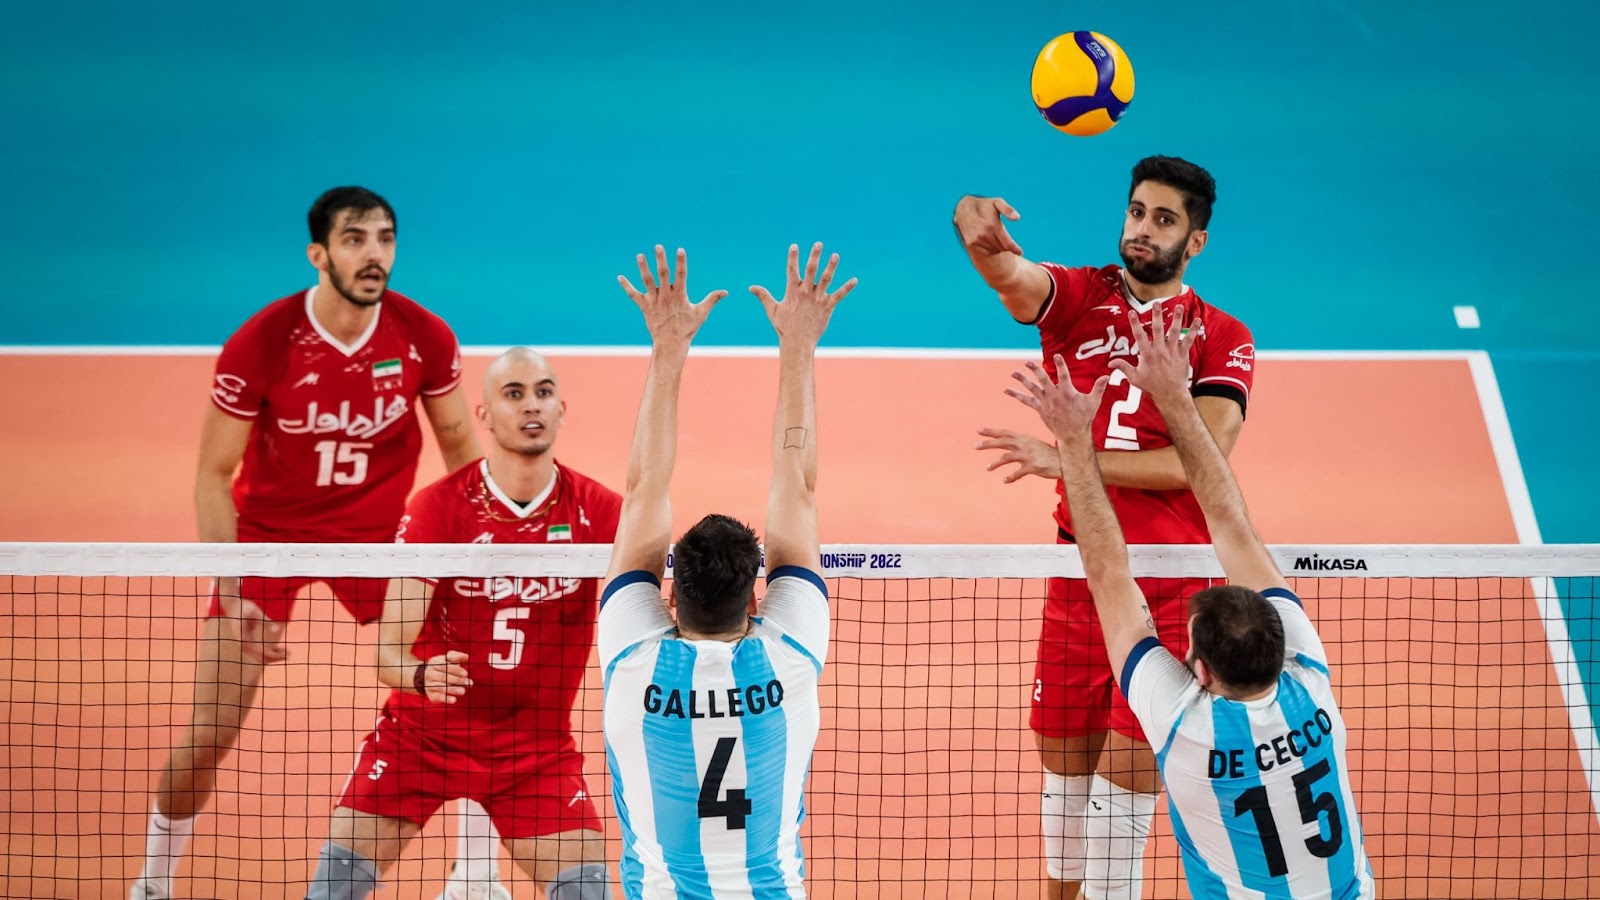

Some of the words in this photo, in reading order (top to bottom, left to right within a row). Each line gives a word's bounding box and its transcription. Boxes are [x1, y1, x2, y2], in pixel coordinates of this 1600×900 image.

[1107, 367, 1143, 441] 2
[315, 440, 374, 486] 15
[820, 553, 866, 568] IONSHIP
[870, 553, 902, 568] 2022
[488, 607, 530, 670] 5
[643, 679, 784, 719] GALLEGO
[1033, 678, 1042, 702] 2
[368, 759, 388, 780] 5
[1208, 749, 1245, 779] DE
[1254, 708, 1333, 772] CECCO
[697, 737, 752, 830] 4
[1234, 757, 1343, 878] 15
